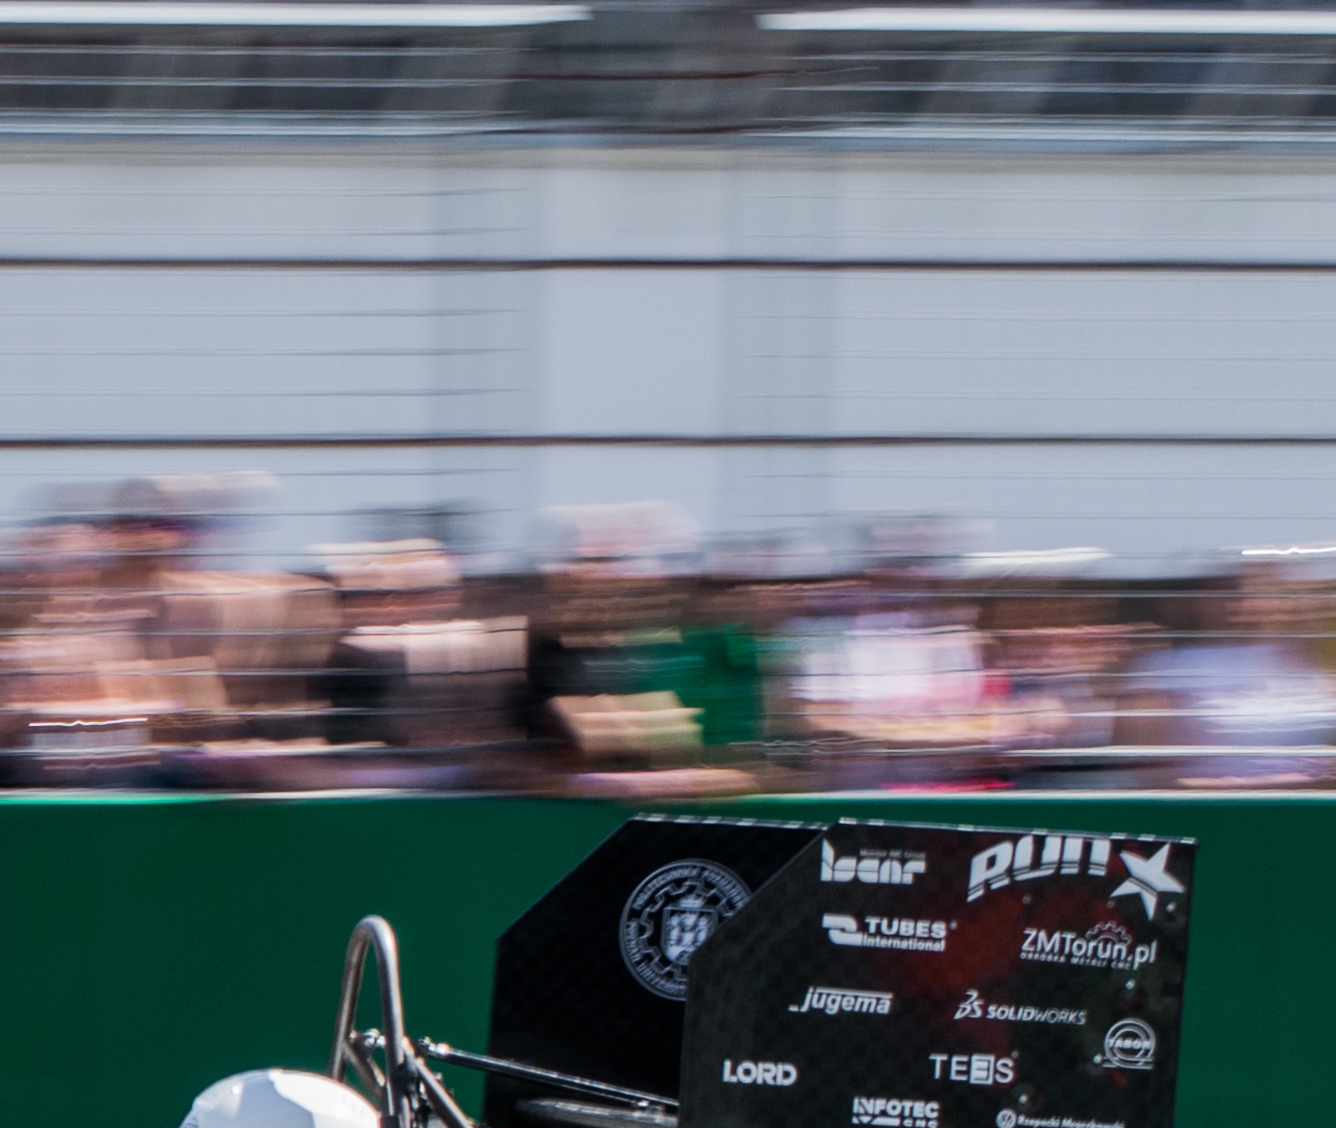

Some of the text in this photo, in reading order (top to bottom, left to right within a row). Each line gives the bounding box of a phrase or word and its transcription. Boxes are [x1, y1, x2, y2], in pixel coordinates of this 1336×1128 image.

[865, 915, 947, 939] TUBES
[863, 934, 946, 952] International
[1021, 927, 1158, 971] ZMTorun.pl
[800, 987, 893, 1015] jugema
[985, 1004, 1088, 1026] SOLIDWORKS
[722, 1060, 798, 1087] LORD
[851, 1097, 941, 1119] INFOTEC
